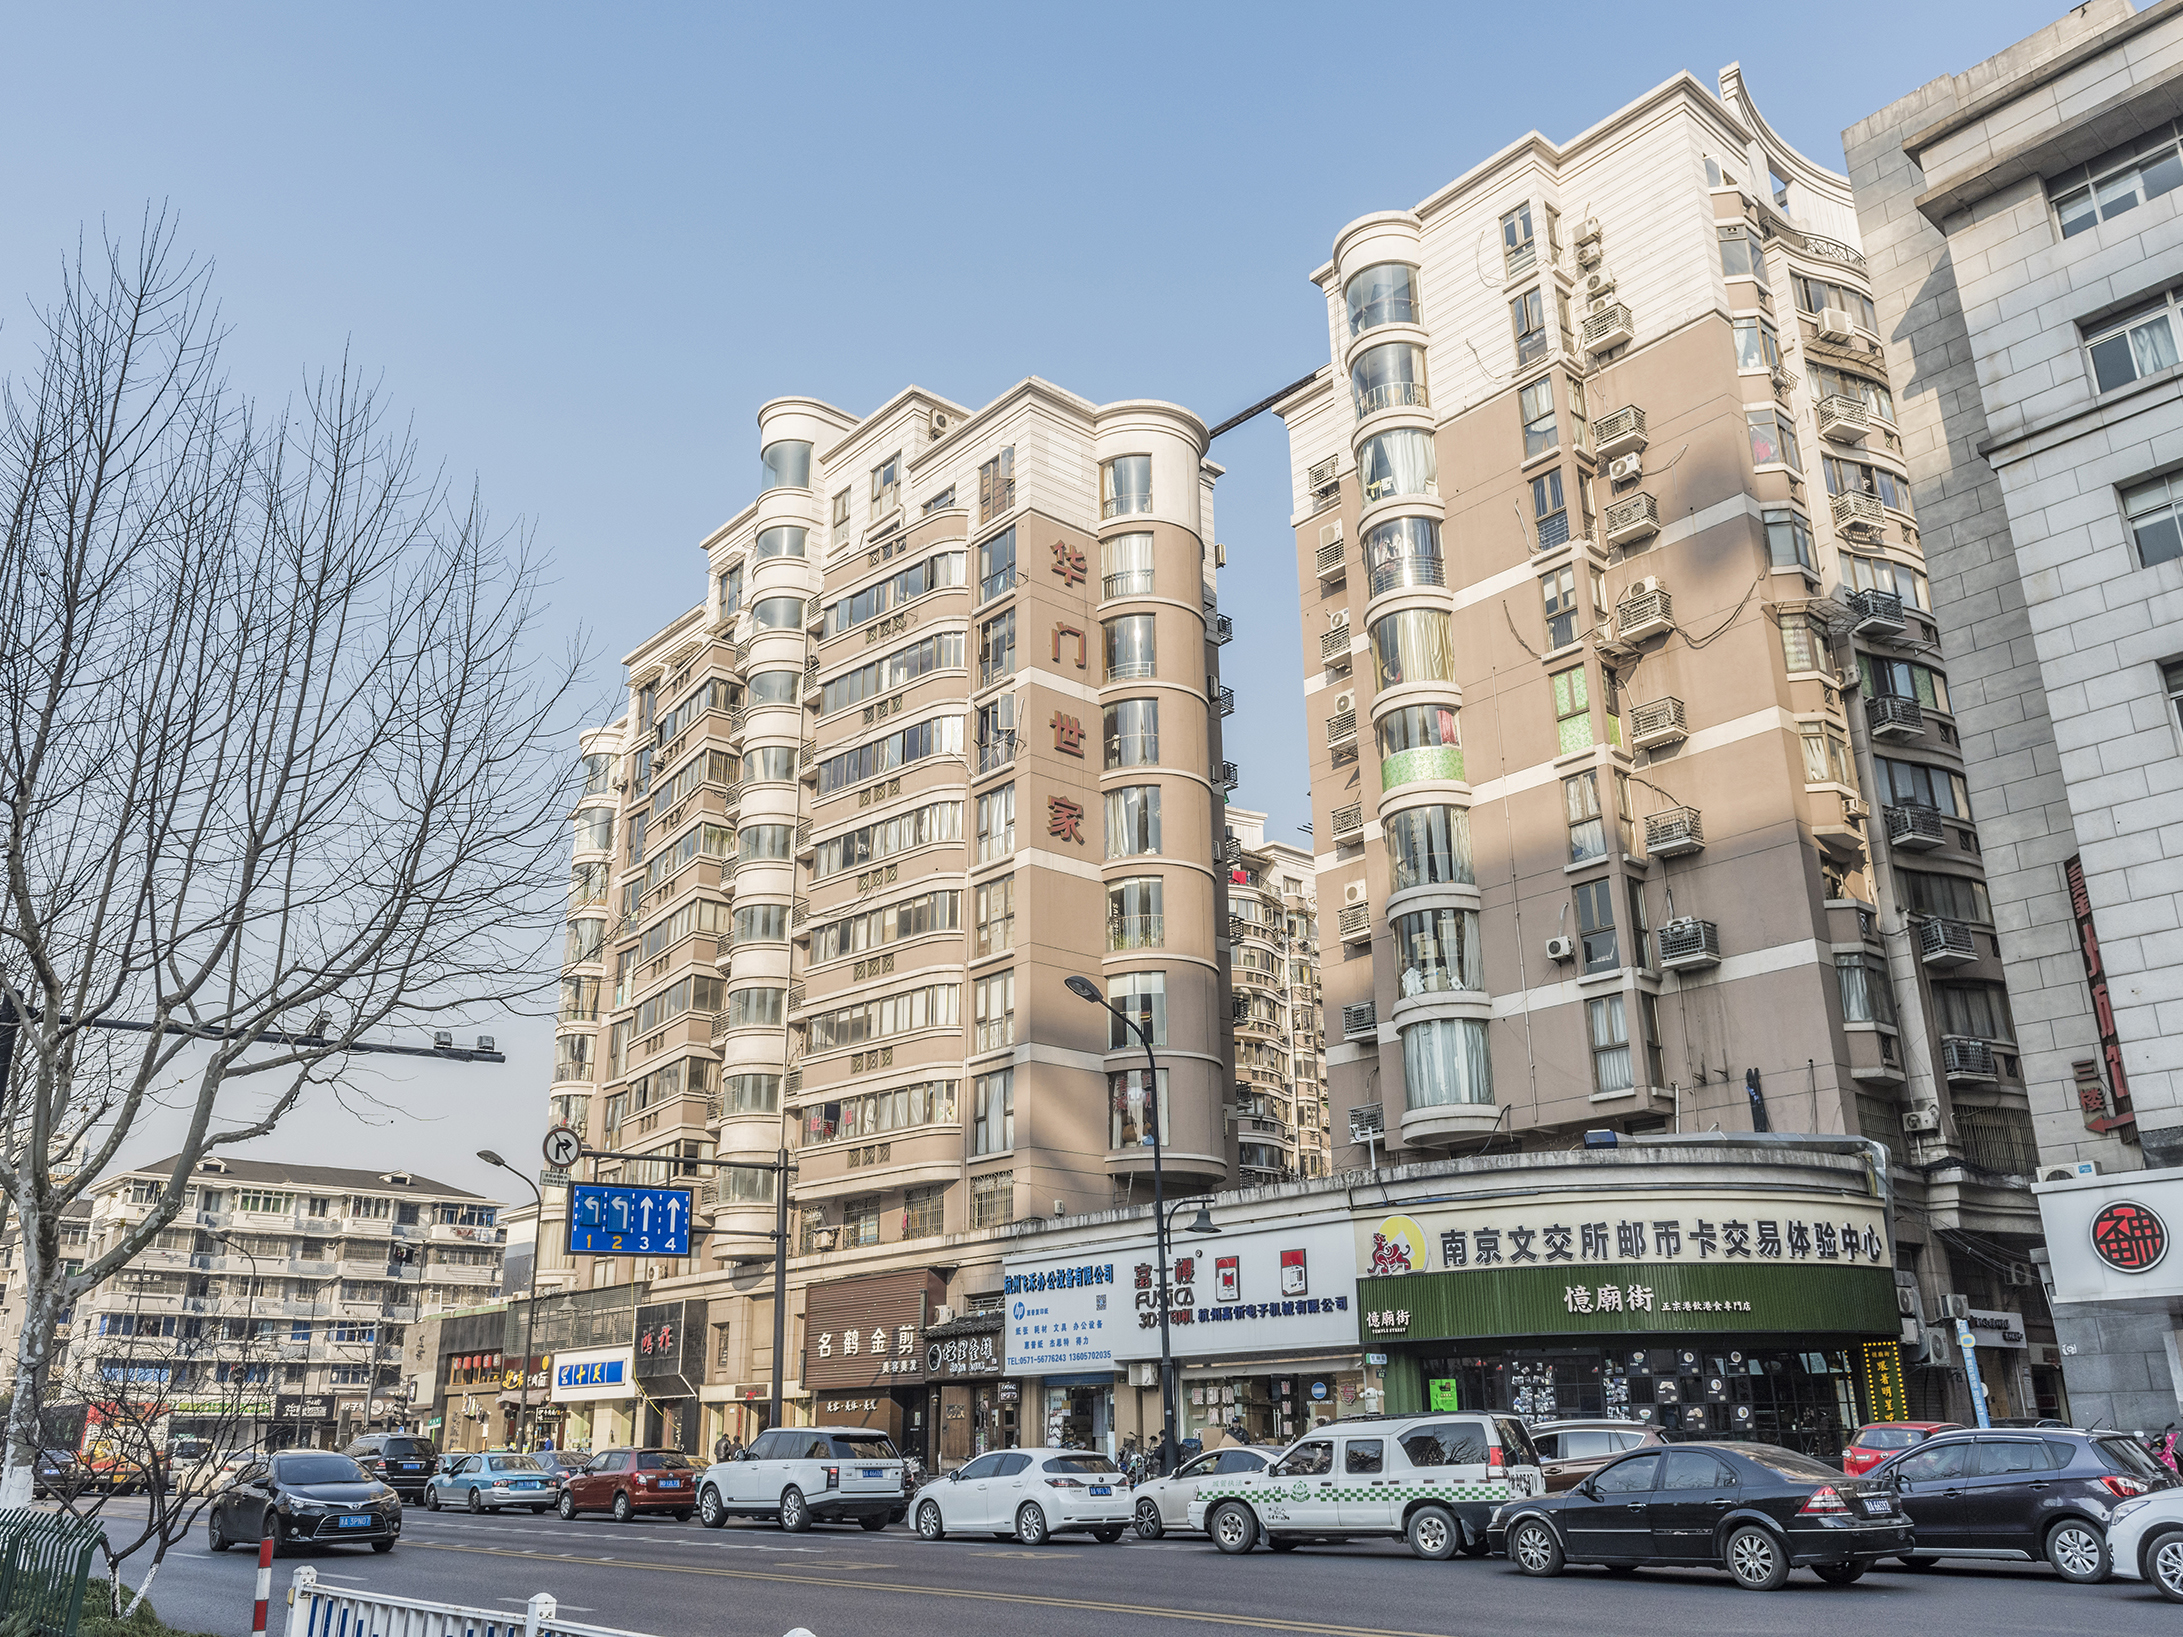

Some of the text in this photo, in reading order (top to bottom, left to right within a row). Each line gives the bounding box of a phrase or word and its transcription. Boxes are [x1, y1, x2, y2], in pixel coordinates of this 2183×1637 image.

[1047, 538, 1088, 847] 华门世家
[586, 1234, 677, 1251] 1 2 3 4
[1440, 1218, 1883, 1267] 南京文交所邮币卡交易体验中心
[1004, 1264, 1114, 1295] 杭州飞禾办公设备有限公司
[1563, 1283, 1654, 1314] 憶廟街
[1015, 1319, 1103, 1335] 纸张 耗材 文具 办公设备
[1366, 1309, 1411, 1328] 憶廟街
[818, 1324, 916, 1358] 名鹤金剪
[1069, 1350, 1112, 1362] 13605702035
